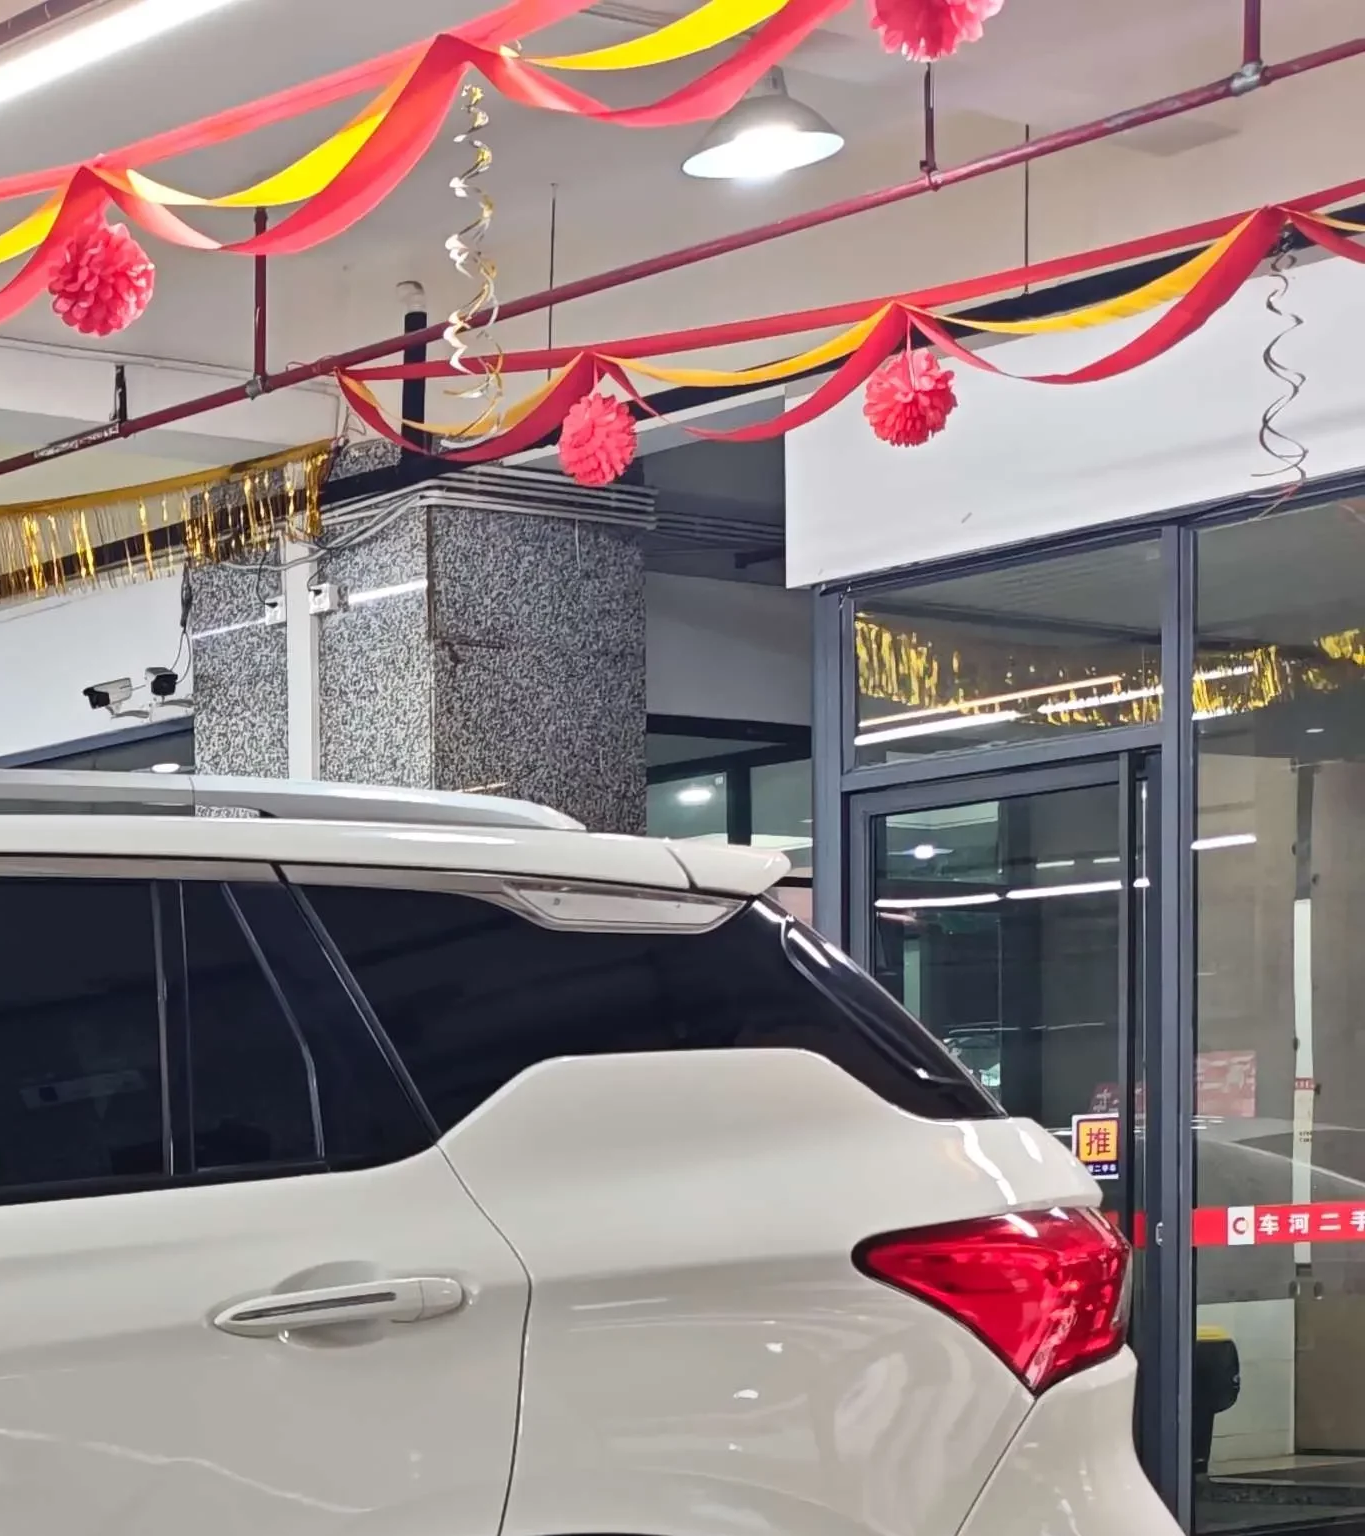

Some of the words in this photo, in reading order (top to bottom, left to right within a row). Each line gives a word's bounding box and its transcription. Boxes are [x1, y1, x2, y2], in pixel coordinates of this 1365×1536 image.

[1085, 1127, 1111, 1156] 推
[1258, 1211, 1365, 1235] 车河二手
